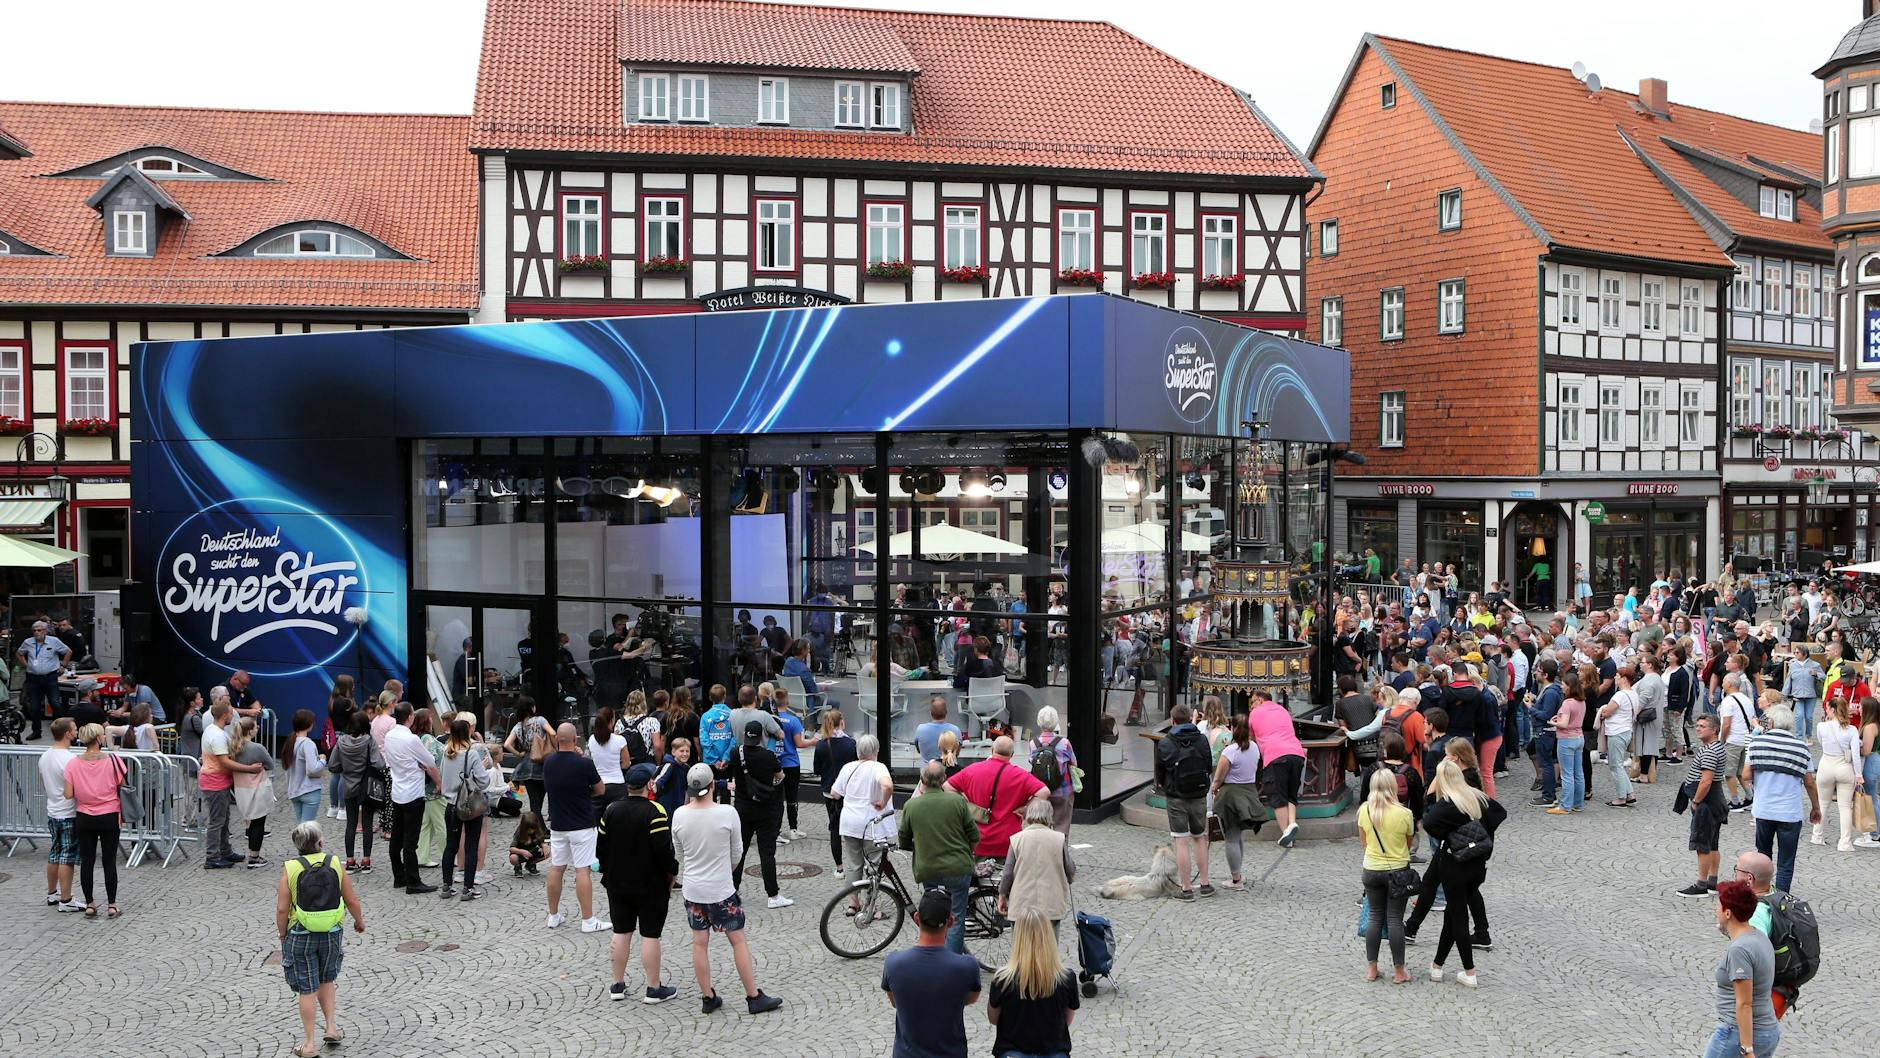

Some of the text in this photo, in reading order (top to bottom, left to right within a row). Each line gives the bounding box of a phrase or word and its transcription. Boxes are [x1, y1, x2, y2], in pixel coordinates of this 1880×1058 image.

[706, 293, 744, 312] Hotel
[751, 291, 797, 306] Weißer
[1377, 485, 1433, 495] BLUME 2000
[1629, 484, 1679, 494] BLUME 2000
[200, 525, 280, 553] Deutschland
[210, 552, 260, 570] sucht den
[164, 551, 358, 641] SuperStar
